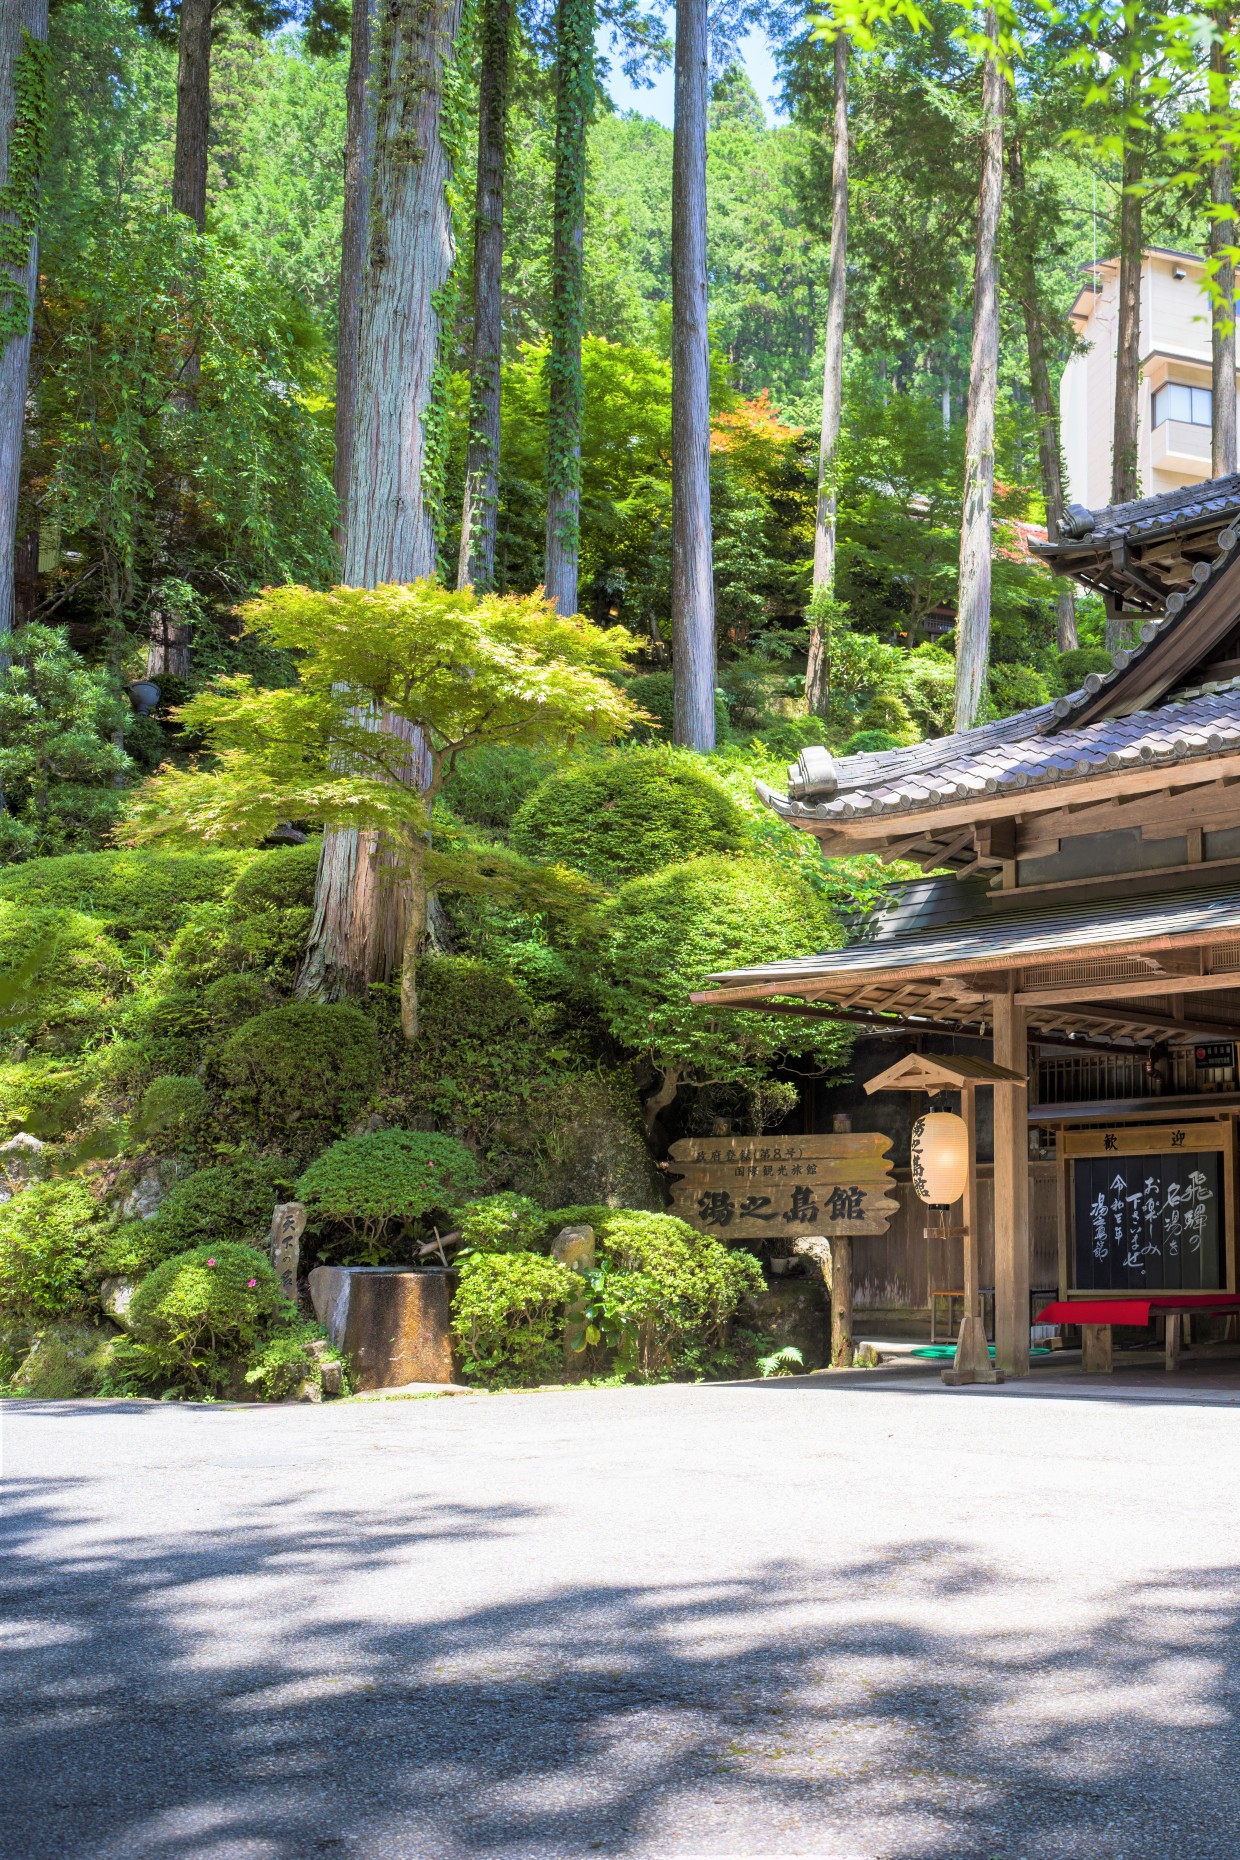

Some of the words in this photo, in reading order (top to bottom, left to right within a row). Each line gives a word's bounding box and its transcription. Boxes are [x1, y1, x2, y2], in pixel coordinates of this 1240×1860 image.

[1103, 1129, 1186, 1151] 歓迎
[734, 1163, 818, 1177] 国際観光旅館
[697, 1185, 868, 1227] 湯之島館
